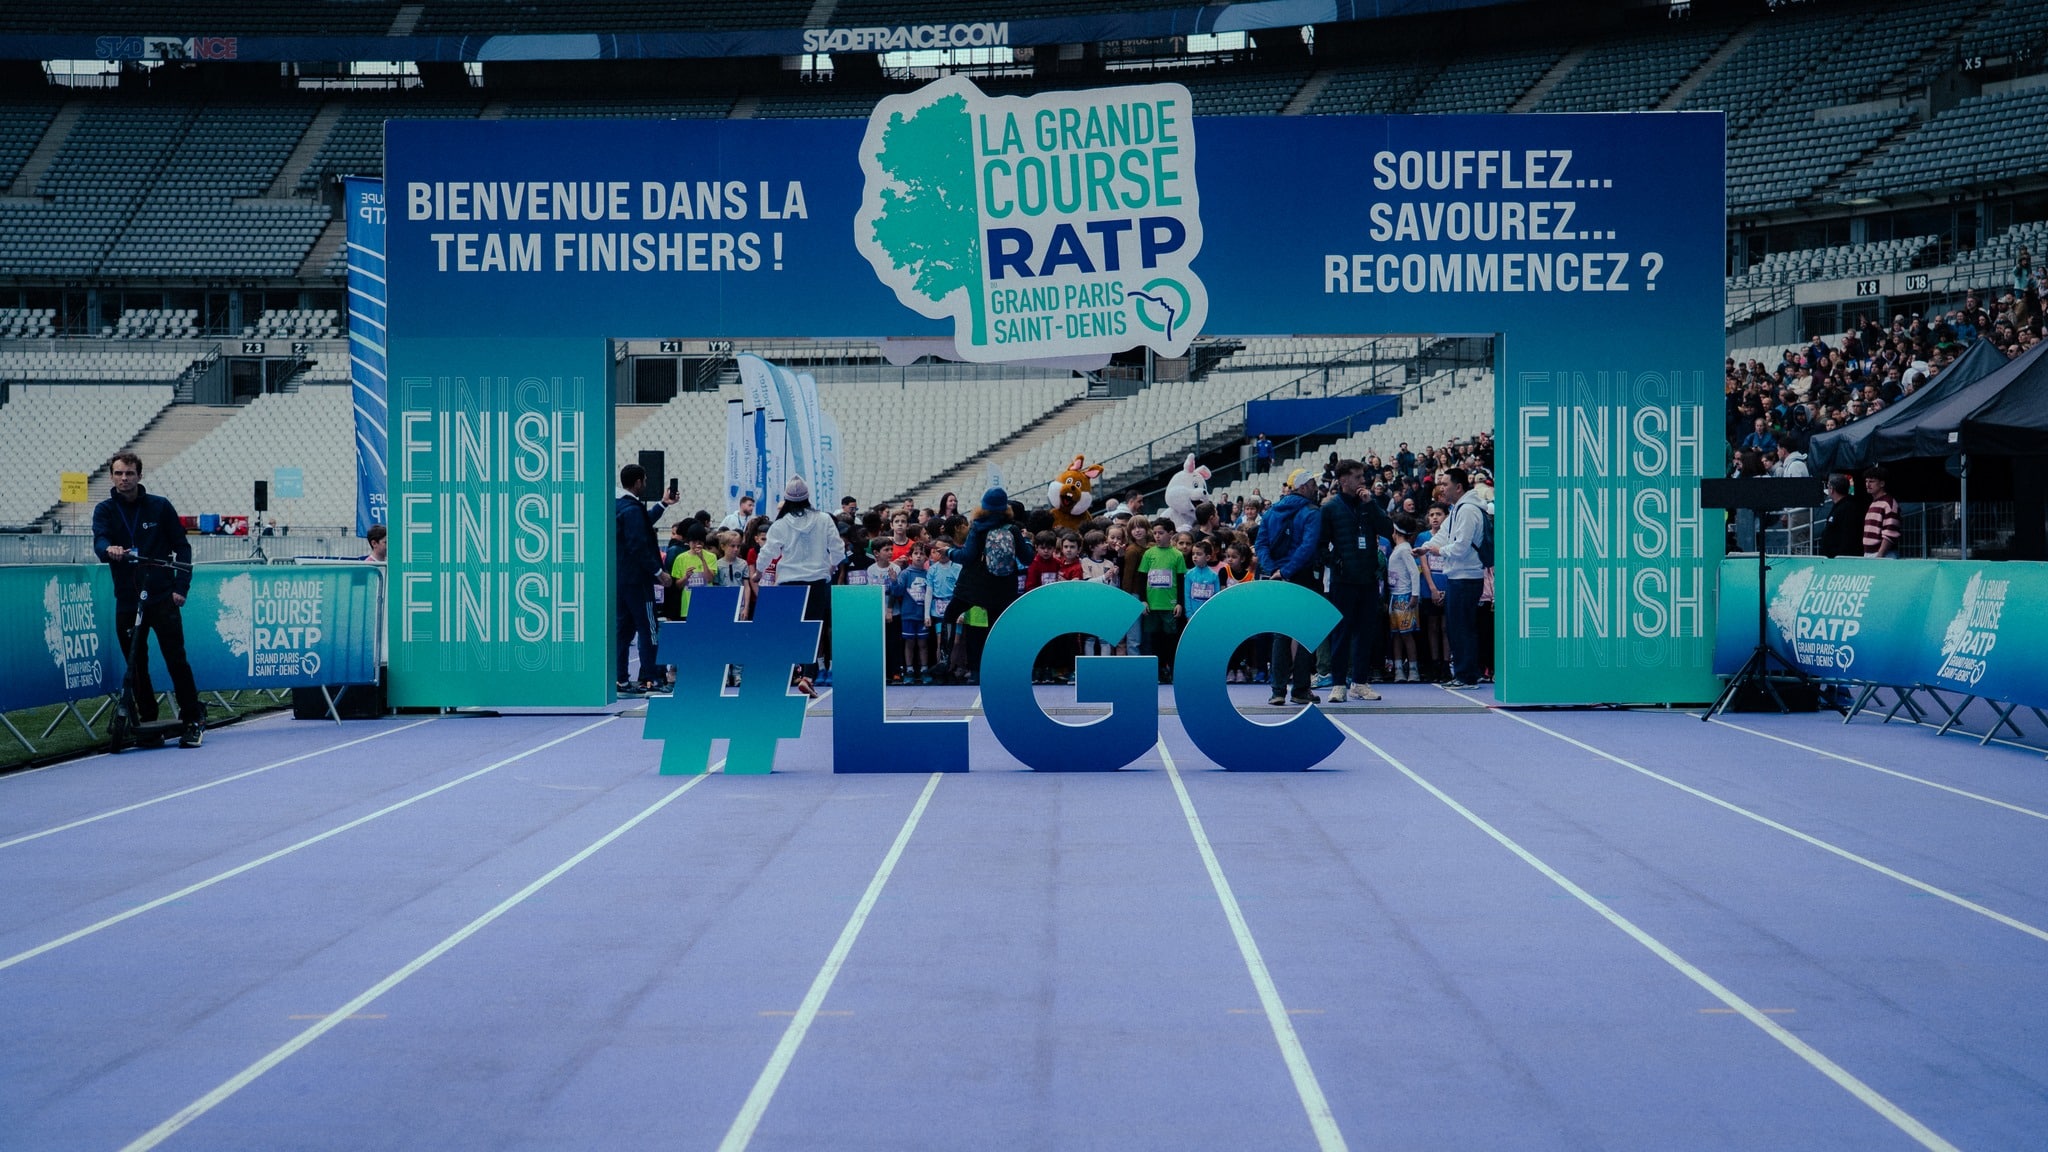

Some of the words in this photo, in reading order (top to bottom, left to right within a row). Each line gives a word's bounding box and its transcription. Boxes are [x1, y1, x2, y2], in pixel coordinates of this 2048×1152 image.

[803, 22, 1009, 53] STADEFRANCE.COM
[979, 112, 1025, 156] LA
[1034, 100, 1178, 152] GRANDE
[982, 146, 1182, 219] COURSE
[1373, 150, 1613, 191] SOUFFLEZ...
[407, 182, 630, 220] BIENVENUE
[641, 181, 748, 220] DANS
[759, 181, 809, 220] LA
[1369, 201, 1616, 242] SAVOUREZ...
[430, 233, 542, 271] TEAM
[555, 232, 761, 271] FINISHERS
[772, 232, 784, 271] !
[986, 216, 1186, 280] RATP
[1324, 253, 1630, 294] RECOMMENCEZ
[1640, 252, 1664, 291] ?
[1907, 276, 1927, 290] U18
[991, 284, 1060, 315] GRAND
[1064, 281, 1124, 308] PARIS
[994, 310, 1127, 344] SAINT-DENIS
[244, 343, 263, 353] Z3
[663, 342, 679, 352] Z1
[401, 411, 584, 482] FINISH
[1518, 406, 1704, 477] FINISH
[401, 492, 584, 563] FINISH
[1518, 488, 1704, 559] FINISH
[60, 583, 68, 603] LA
[68, 582, 93, 602] GRANDE
[254, 580, 271, 599] LA
[273, 580, 324, 599] GRANDE
[1809, 574, 1826, 591] LA
[1826, 575, 1876, 593] GRANDE
[61, 603, 97, 632] COURSE
[254, 599, 322, 625] COURSE
[401, 571, 584, 642] FINISH
[1518, 567, 1704, 638] FINISH
[1800, 591, 1869, 618] COURSE
[1970, 600, 2005, 630] COURSE
[255, 627, 322, 650] RATP
[1797, 616, 1860, 642] RATP
[1957, 630, 1997, 657] RATP
[64, 633, 99, 660] RATP
[255, 652, 279, 665] GRAND
[279, 652, 300, 664] PARIS
[1798, 642, 1816, 654] GRAND
[1816, 643, 1835, 656] PARIS
[1800, 654, 1834, 668] SAINT-DENIS
[255, 664, 300, 677] SAINT-DENIS
[642, 580, 1346, 776] #LGC
